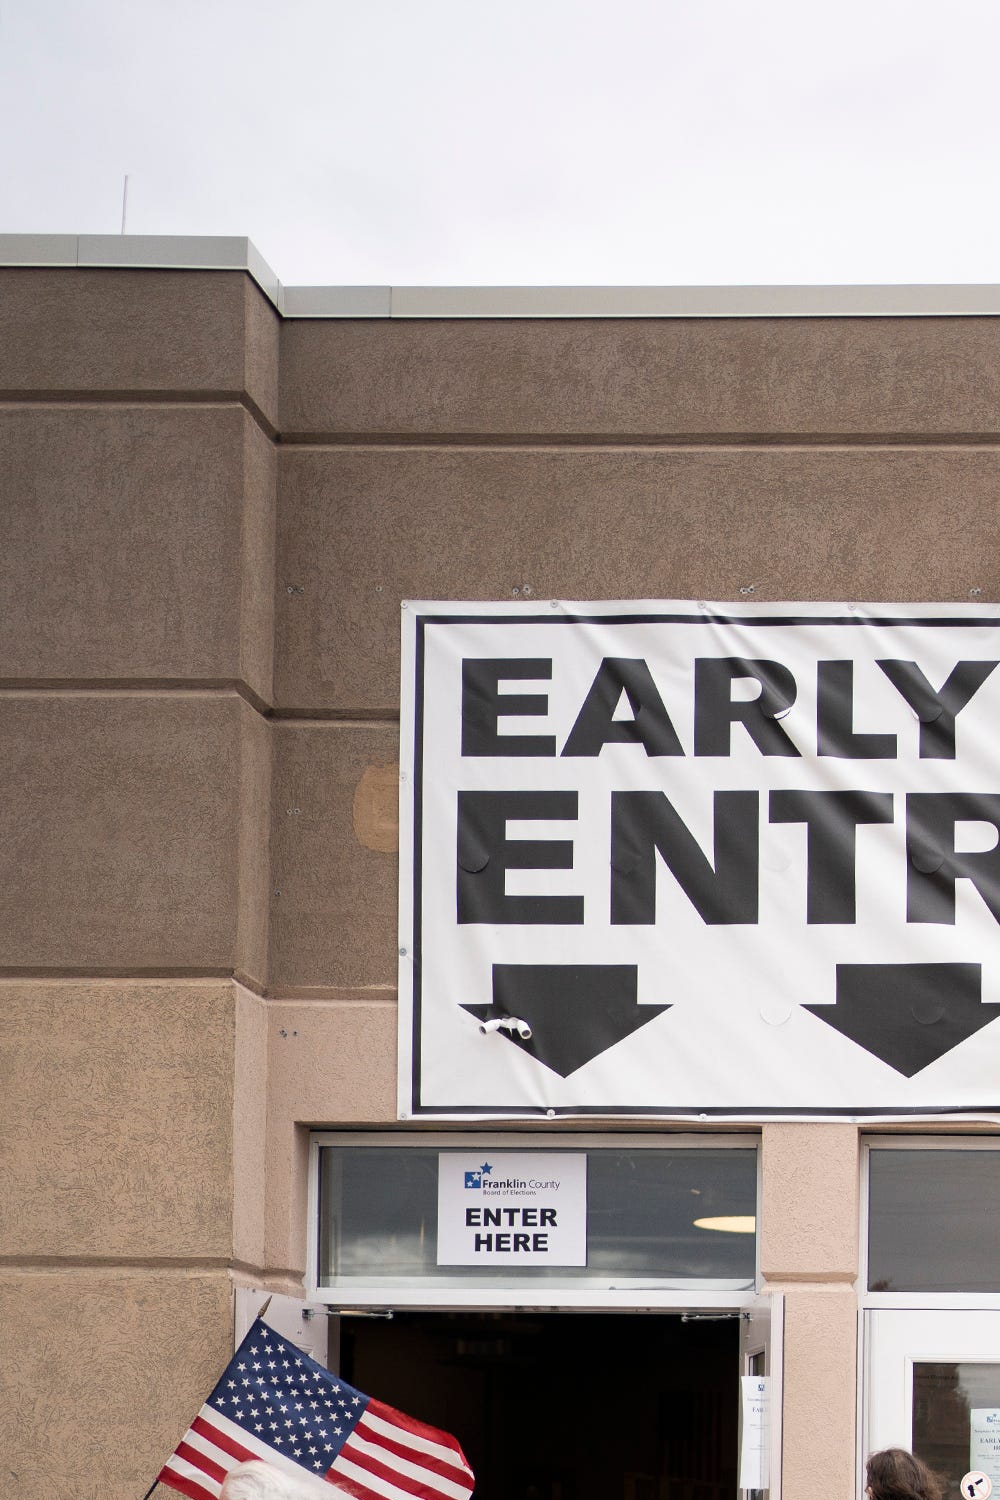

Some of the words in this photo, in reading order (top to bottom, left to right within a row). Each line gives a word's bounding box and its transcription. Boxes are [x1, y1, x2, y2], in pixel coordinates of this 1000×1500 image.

[461, 657, 1000, 760] EARLY
[482, 1179, 527, 1189] Franklin
[528, 1179, 561, 1191] County
[465, 1208, 558, 1227] ENTER
[474, 1233, 549, 1252] HERE
